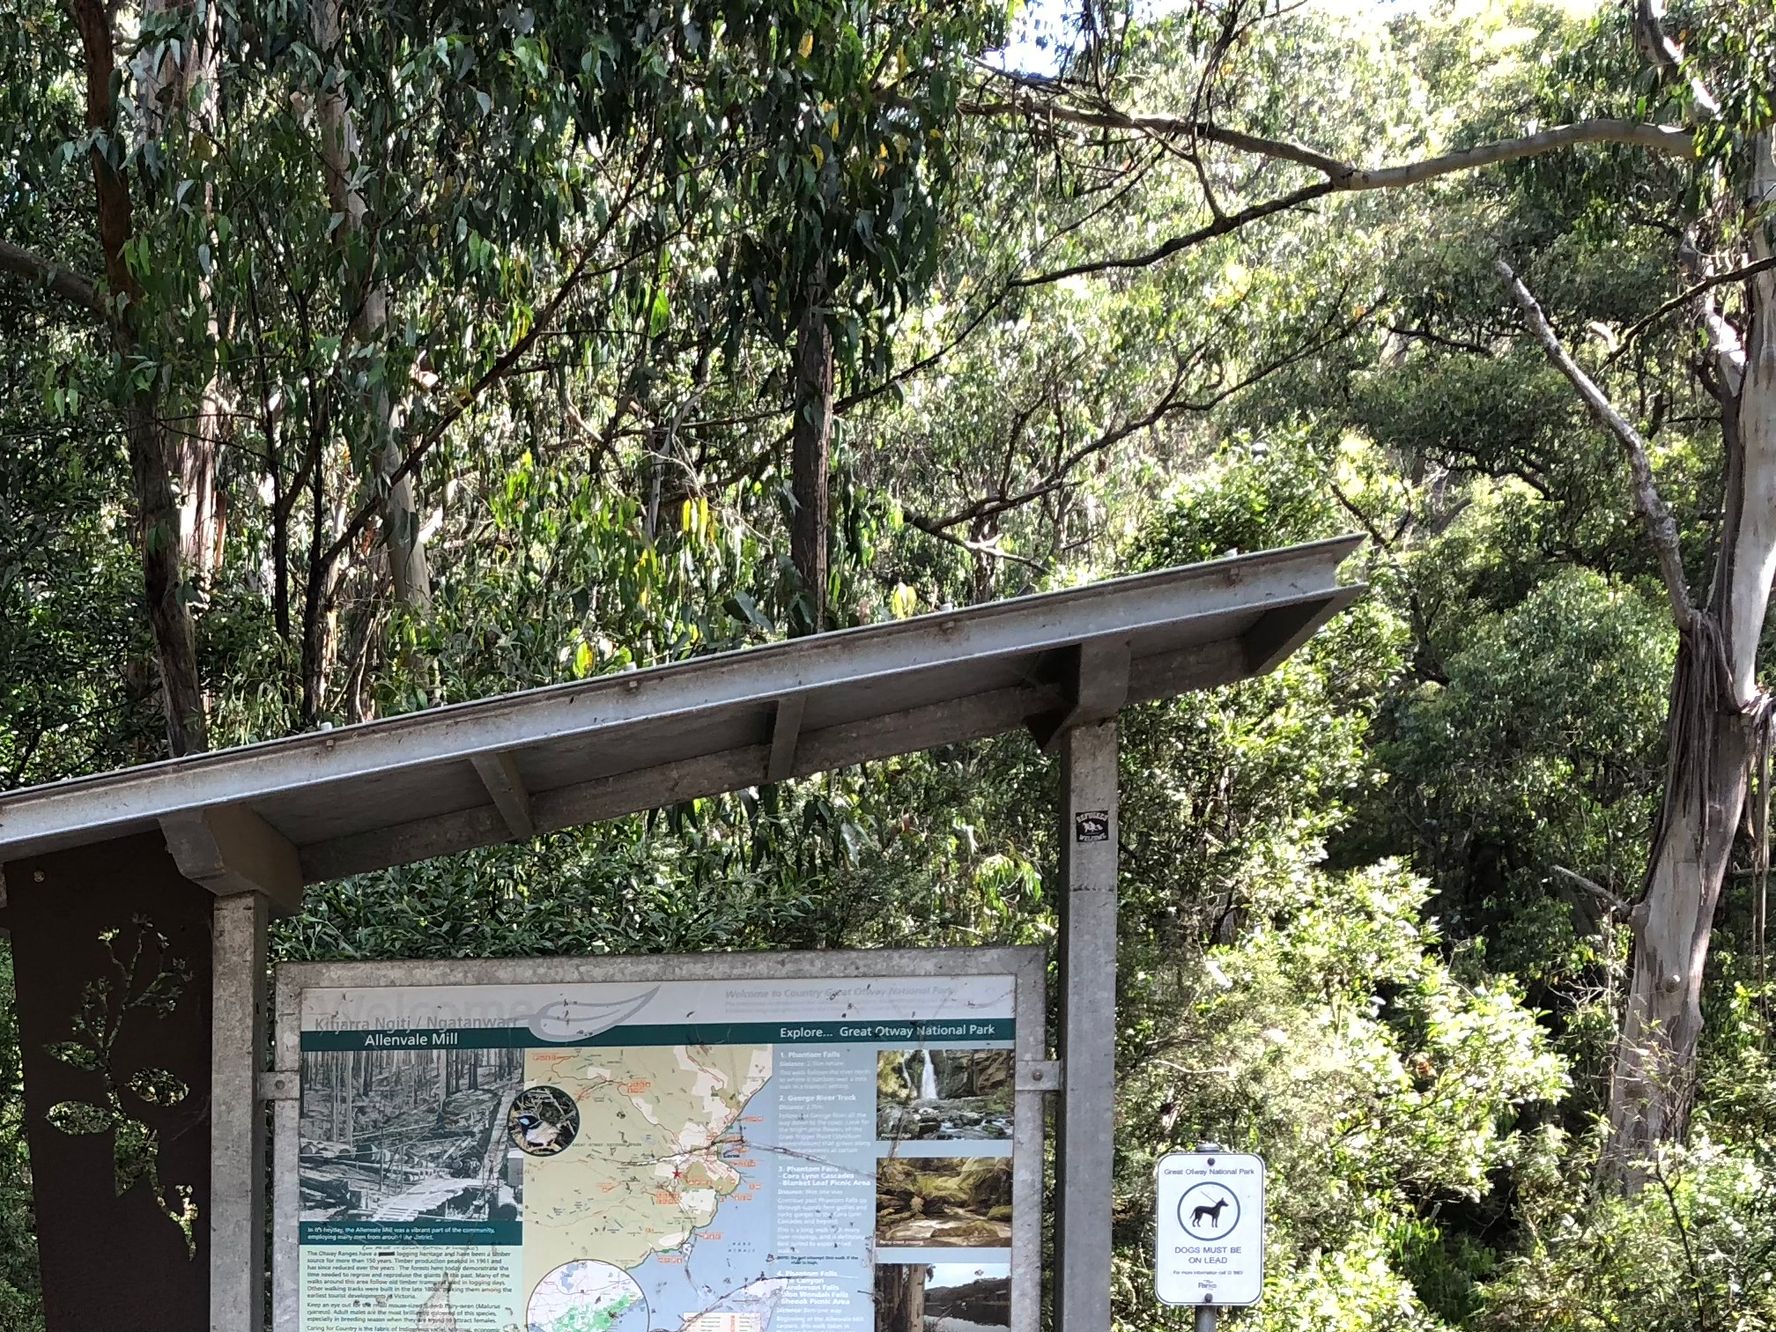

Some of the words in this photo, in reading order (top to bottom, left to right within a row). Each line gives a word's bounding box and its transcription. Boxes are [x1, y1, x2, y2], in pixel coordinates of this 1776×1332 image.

[771, 990, 782, 998] to
[780, 1027, 833, 1039] Explore...
[839, 1026, 872, 1037] Great
[875, 1026, 913, 1039] Otway
[919, 1025, 966, 1036] National
[969, 1024, 995, 1035] Park
[365, 1034, 428, 1046] Allenvale
[432, 1033, 458, 1045] Mill
[1164, 1168, 1184, 1176] Great
[1209, 1168, 1238, 1176] National
[1239, 1168, 1255, 1176] Park
[1175, 1246, 1201, 1254] DOGS
[1203, 1246, 1228, 1254] MUST
[1230, 1246, 1242, 1254] BE
[1188, 1256, 1202, 1264] ON
[1204, 1256, 1228, 1264] LEAD
